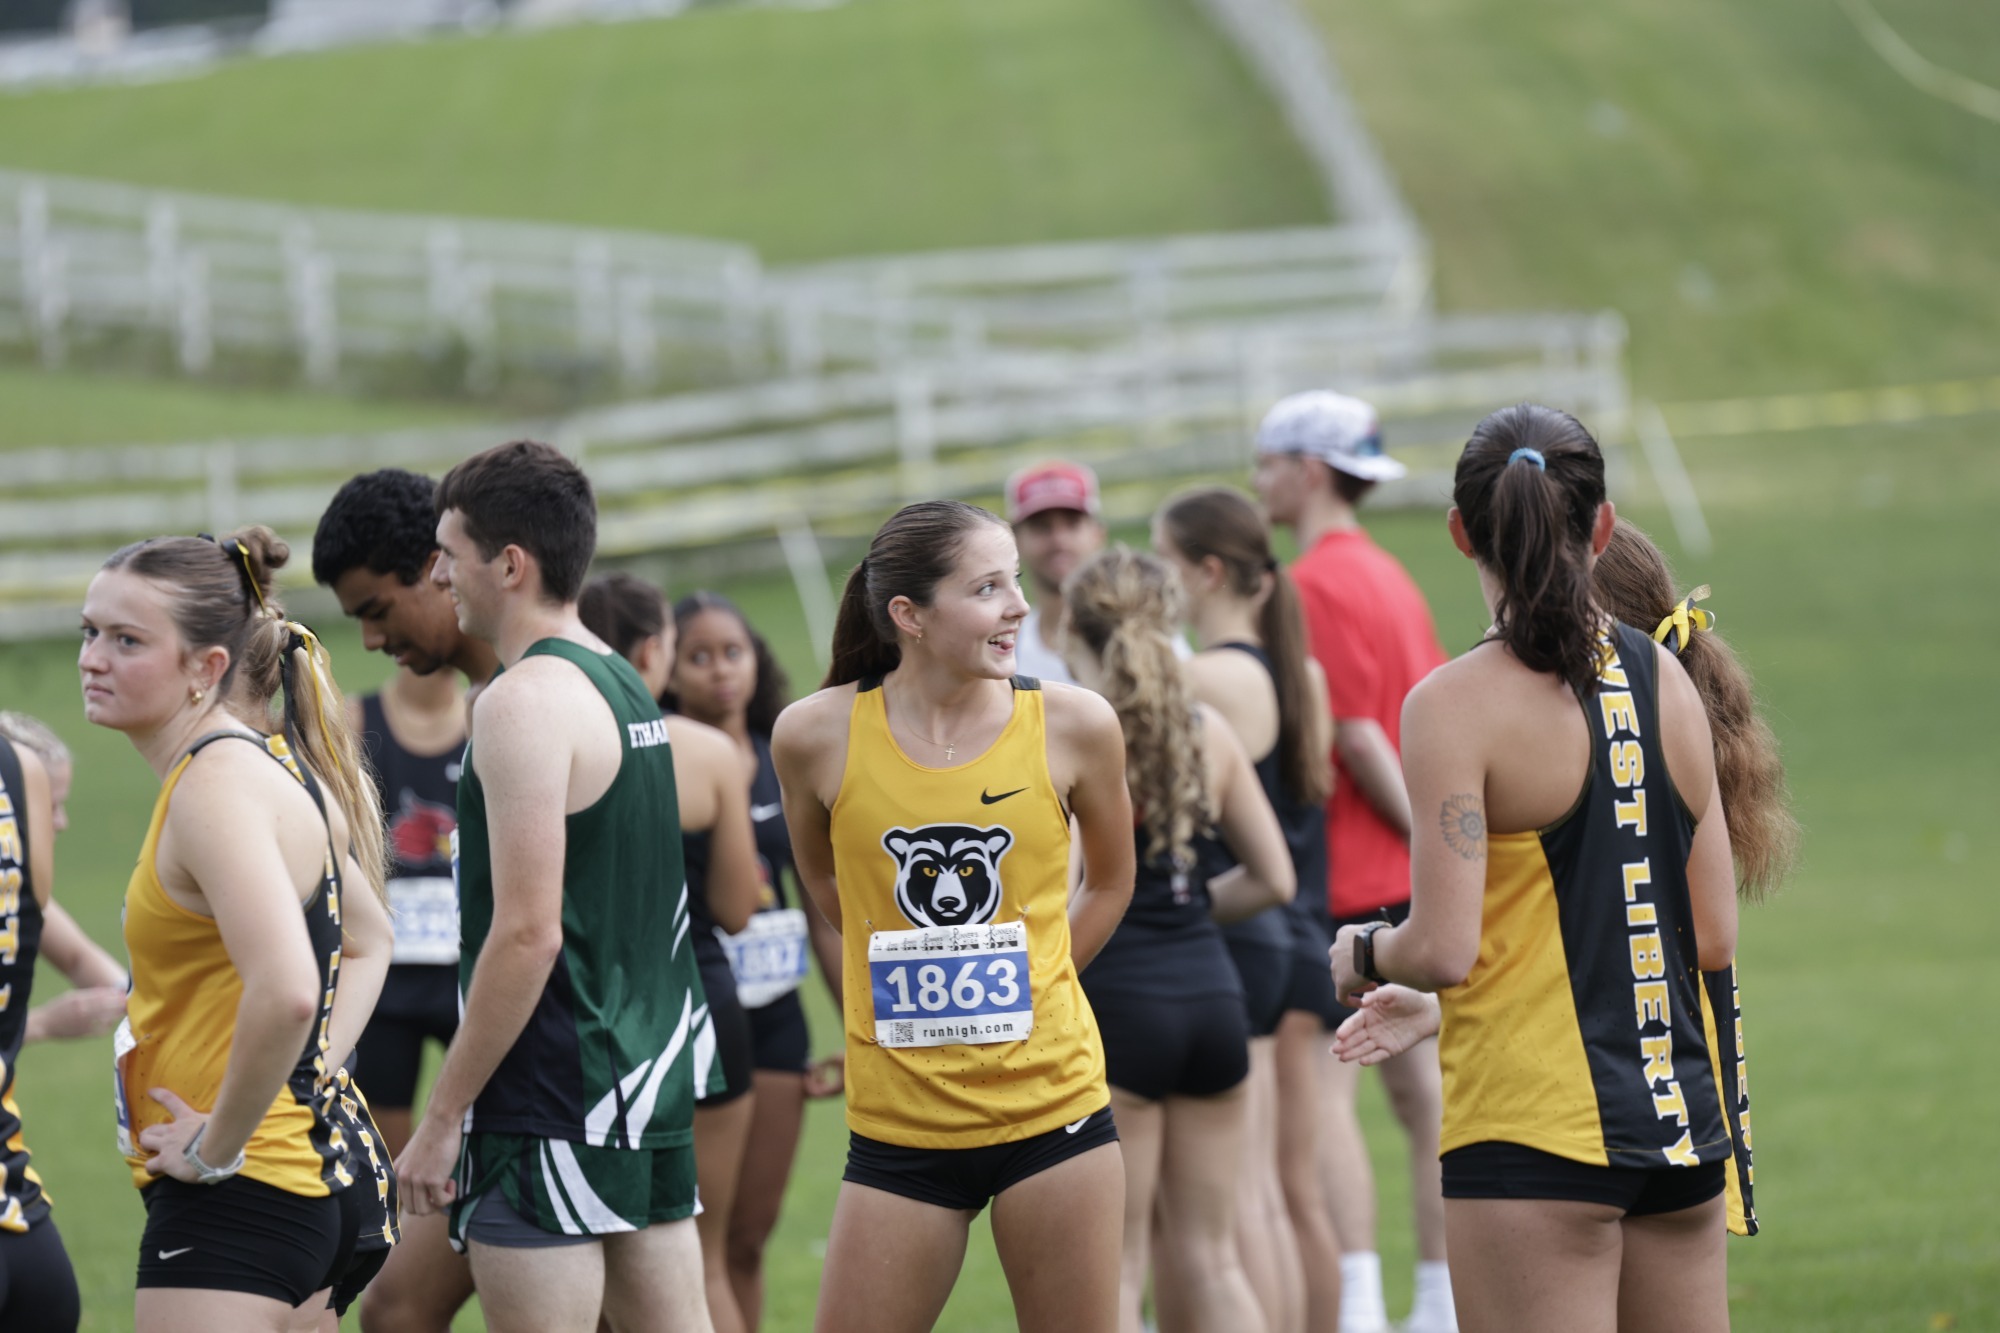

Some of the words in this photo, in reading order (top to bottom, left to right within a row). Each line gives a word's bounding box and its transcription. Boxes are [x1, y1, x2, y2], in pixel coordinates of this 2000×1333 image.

[885, 959, 1020, 1012] 1863
[1622, 856, 1700, 1167] LIBERTY
[923, 1023, 1013, 1038] runhigh.com
